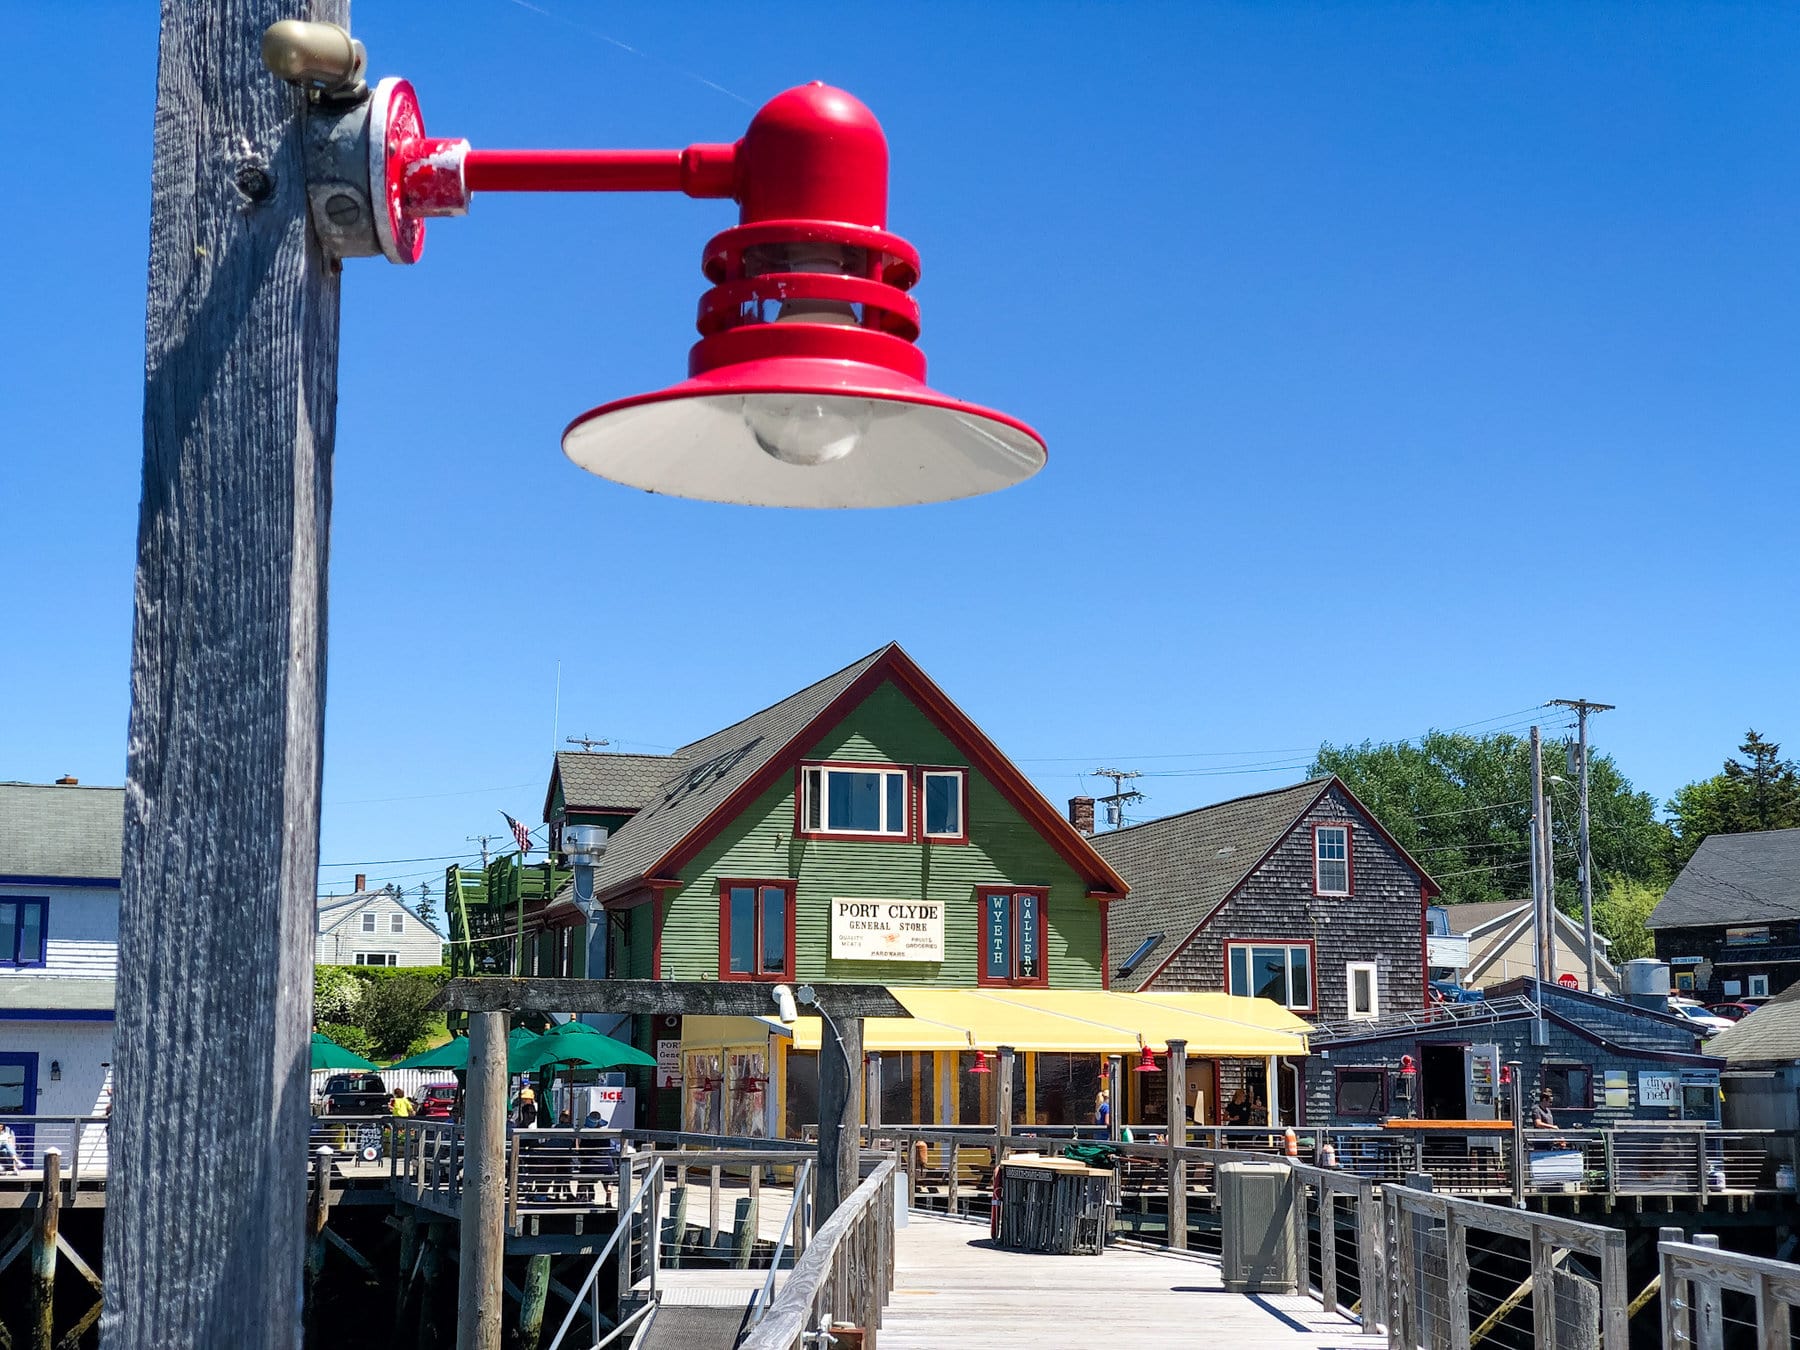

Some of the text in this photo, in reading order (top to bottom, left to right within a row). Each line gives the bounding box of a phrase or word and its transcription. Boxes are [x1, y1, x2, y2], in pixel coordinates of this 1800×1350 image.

[839, 903, 938, 920] PORT CLYDE
[849, 920, 928, 932] GENERAL STORE
[992, 897, 1004, 964] WYETH
[1023, 898, 1033, 977] GALLERY
[1559, 980, 1578, 990] STOP
[1646, 1075, 1664, 1090] dip
[602, 1091, 624, 1100] ICE
[1646, 1089, 1666, 1101] net
